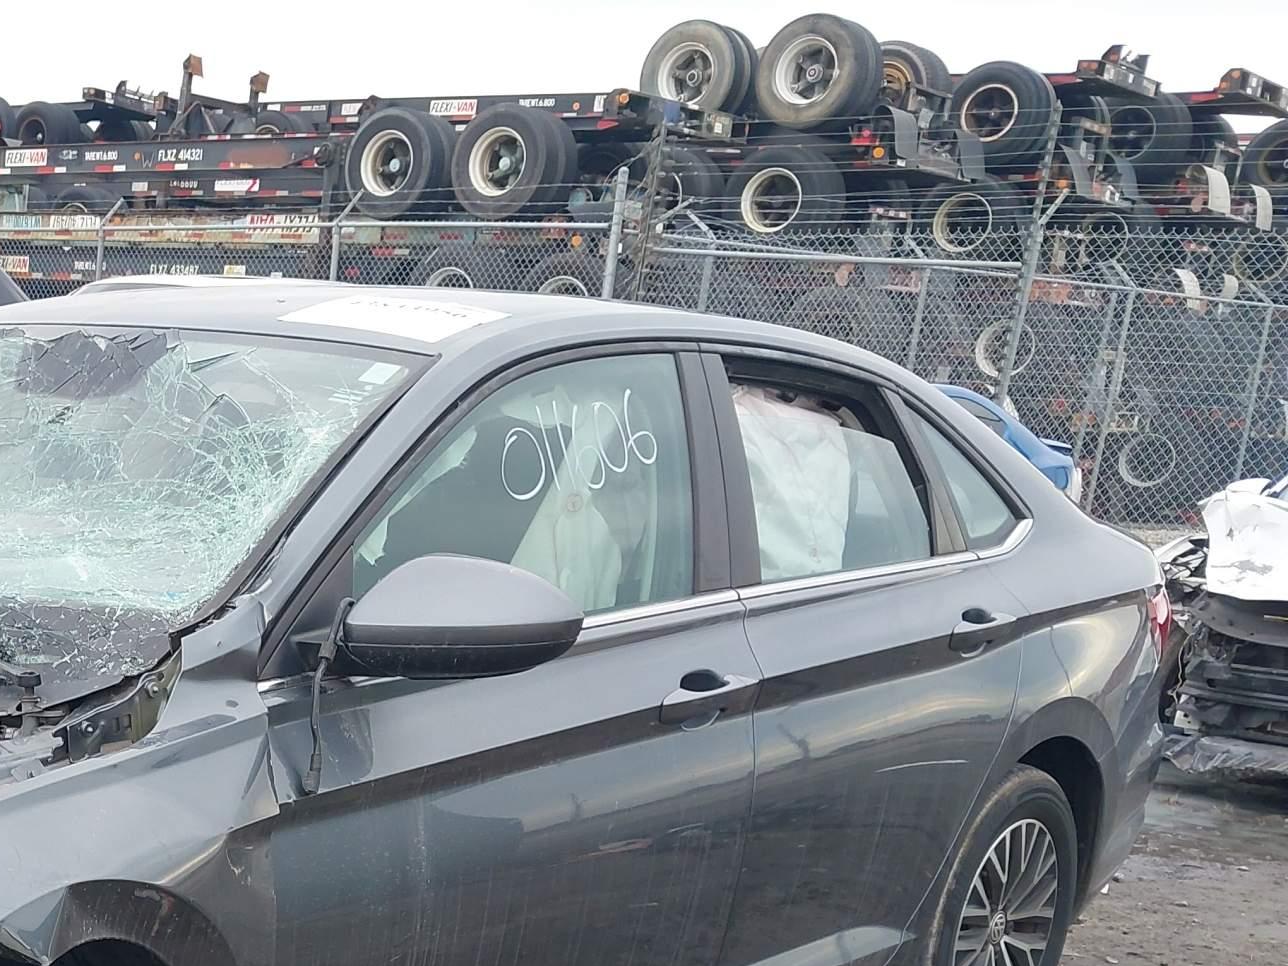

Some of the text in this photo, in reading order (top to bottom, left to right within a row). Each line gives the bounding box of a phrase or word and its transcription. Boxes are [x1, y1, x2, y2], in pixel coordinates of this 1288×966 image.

[431, 101, 475, 113] FLEXI-VAN
[6, 151, 46, 164] FLEXI-VAN
[158, 149, 203, 161] FLXZ 414321
